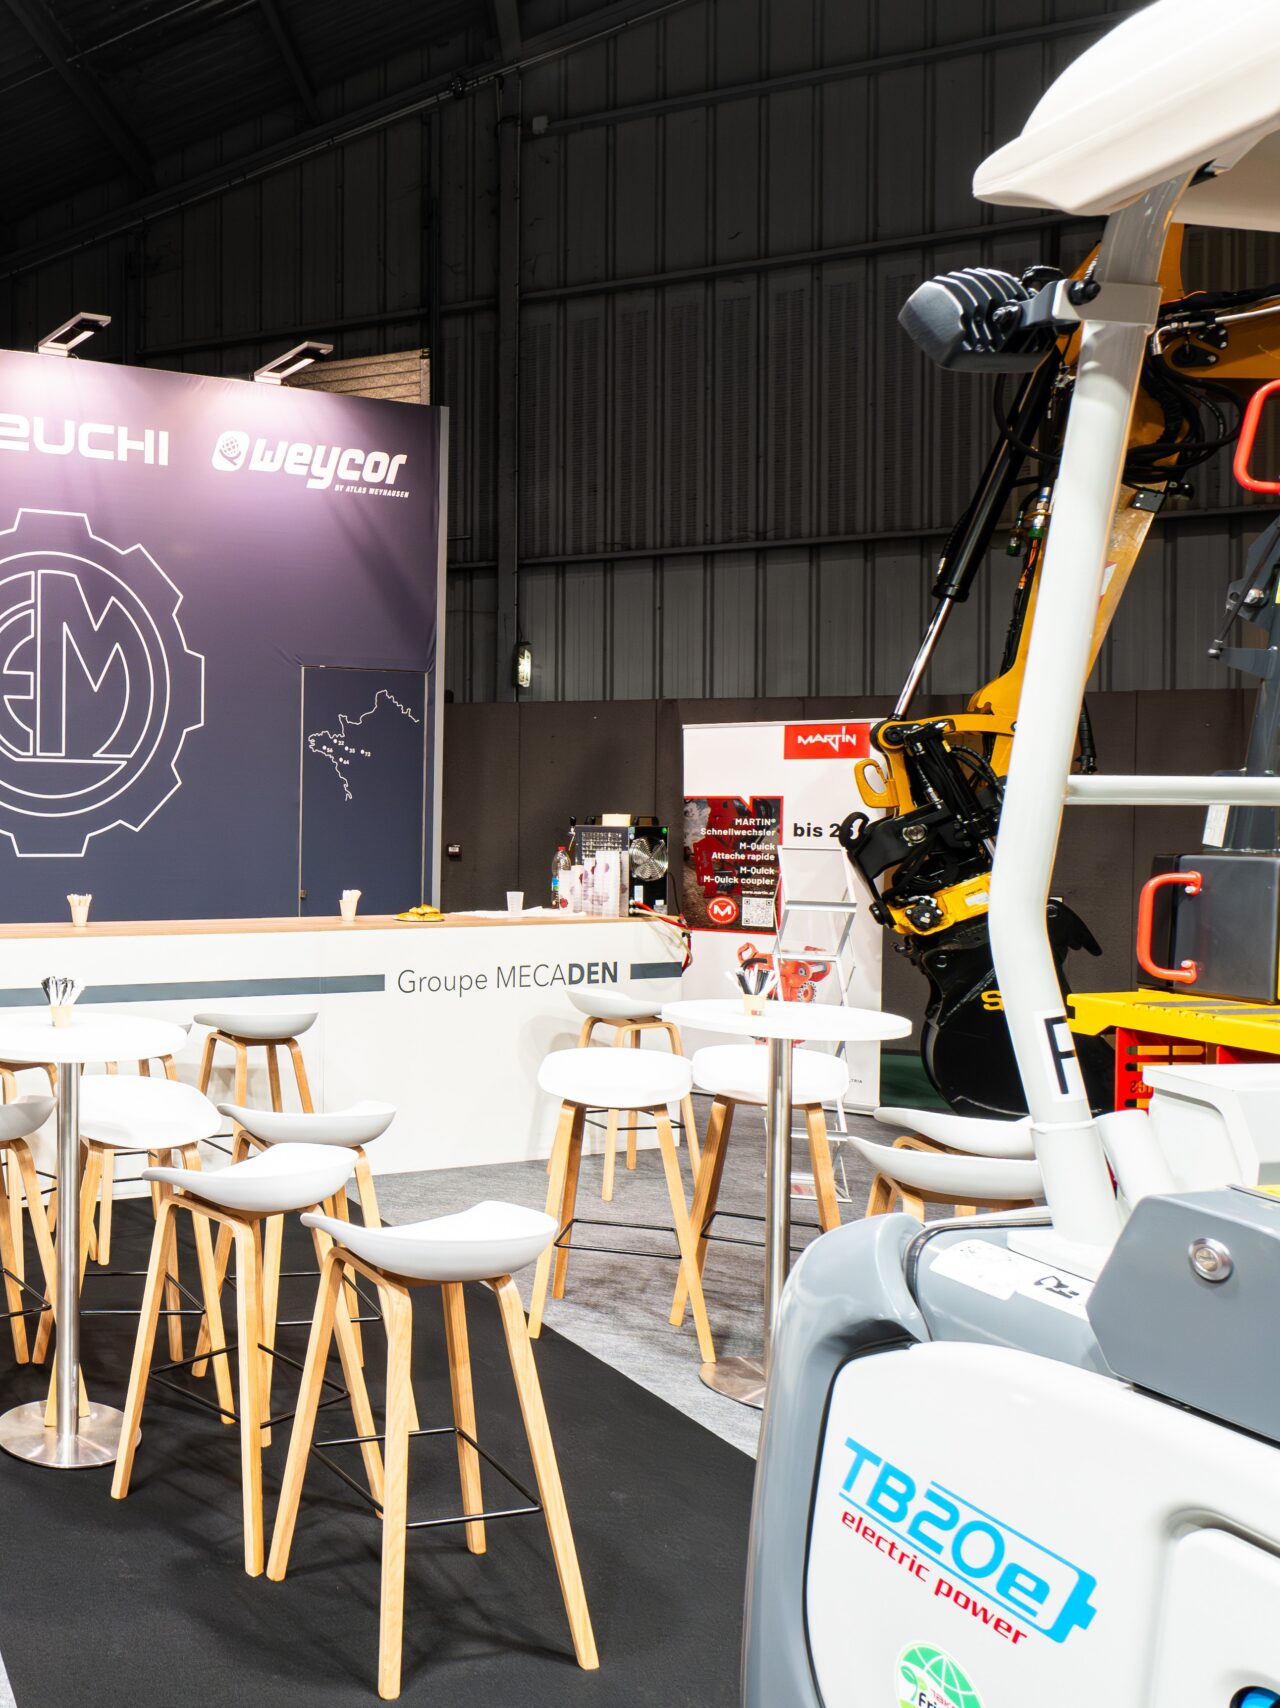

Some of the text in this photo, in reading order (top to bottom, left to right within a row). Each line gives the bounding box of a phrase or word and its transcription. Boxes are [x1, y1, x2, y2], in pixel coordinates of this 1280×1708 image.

[248, 437, 408, 490] weycor
[345, 485, 367, 494] ATLAS
[797, 725, 857, 752] MARTIN
[700, 827, 776, 837] Schnellwechsler
[793, 822, 823, 838] bis
[739, 842, 776, 851] M-Quick
[711, 851, 776, 862] Attache rapide
[739, 866, 775, 875] M-Quick
[703, 875, 775, 886] M-Quick coupler
[397, 961, 618, 998] Groupe MECADEN
[842, 1436, 1051, 1618] TB20e
[841, 1510, 1028, 1645] electric power
